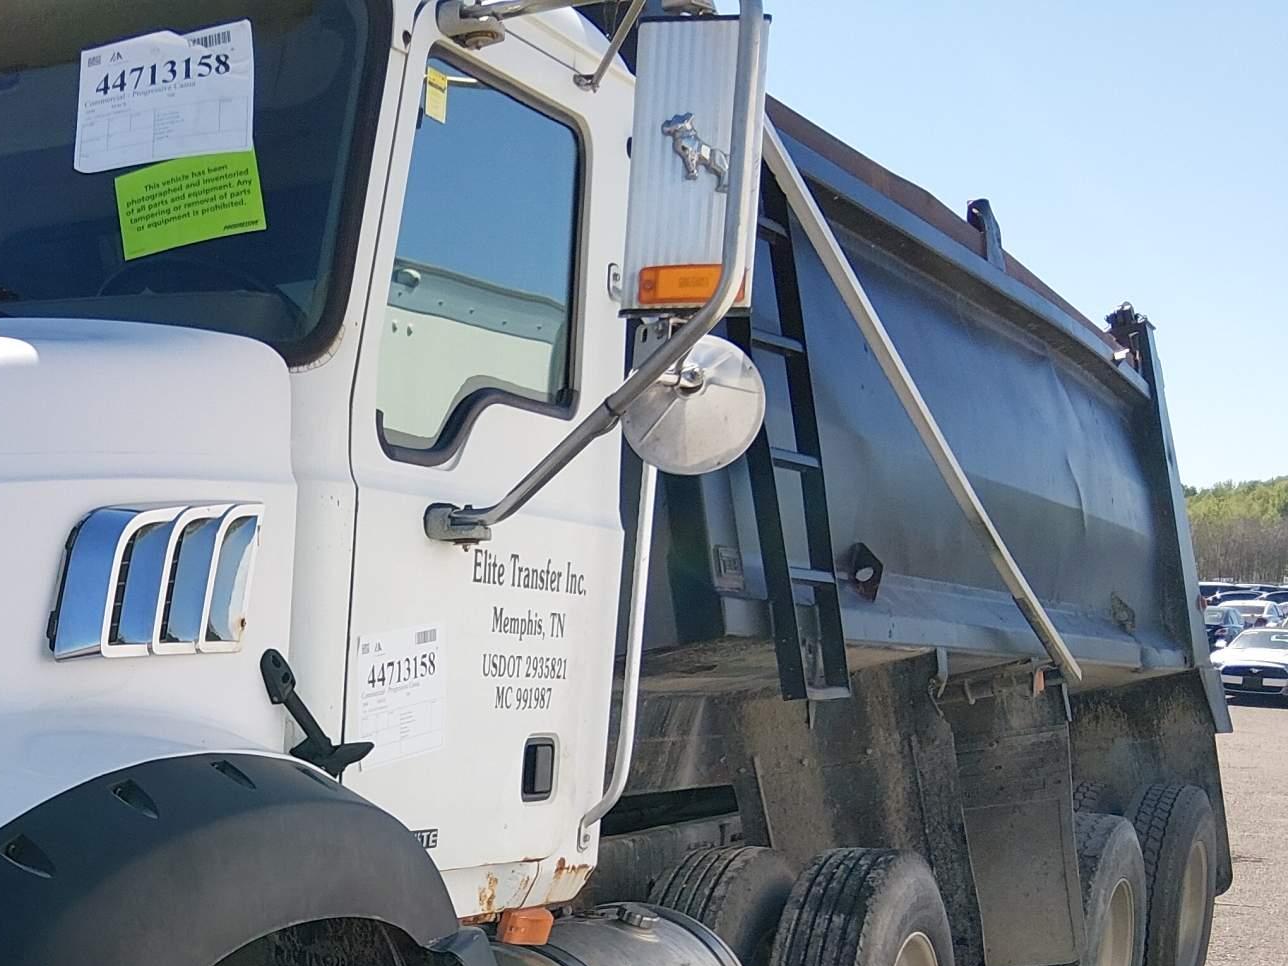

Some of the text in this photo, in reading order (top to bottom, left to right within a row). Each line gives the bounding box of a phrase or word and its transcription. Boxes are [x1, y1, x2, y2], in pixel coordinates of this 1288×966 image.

[96, 54, 231, 95] 44713158
[126, 168, 249, 208] photographed and inventoried
[144, 164, 228, 193] This vehicle has been
[126, 208, 134, 217] of
[148, 199, 168, 211] parts
[170, 193, 185, 203] and
[237, 179, 252, 189] Any
[130, 188, 251, 224] tampering or removal of parts
[147, 211, 191, 229] equipment
[193, 208, 199, 217] is
[472, 548, 587, 596] Elite Transfer Inc.
[491, 606, 566, 641] Memphis, TN
[368, 651, 436, 688] 44713158
[482, 653, 568, 680] USDOT 2935821
[495, 686, 553, 710] MC 991987
